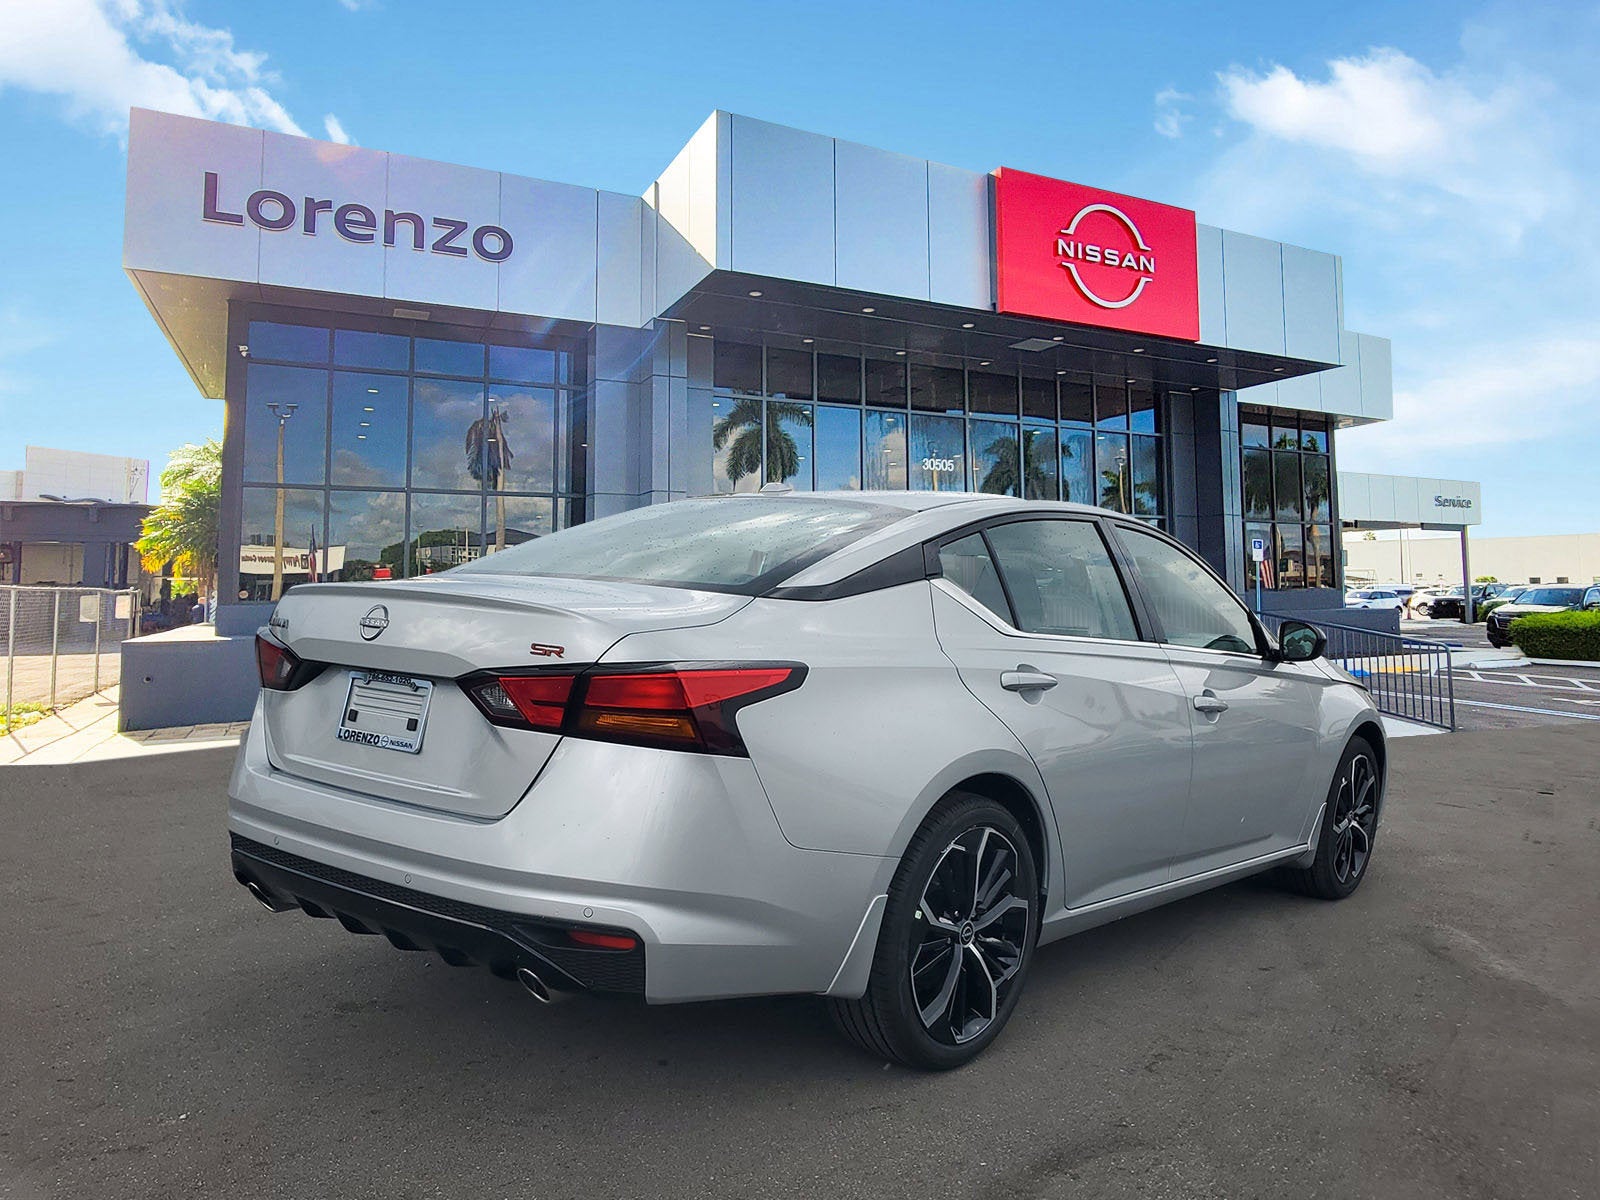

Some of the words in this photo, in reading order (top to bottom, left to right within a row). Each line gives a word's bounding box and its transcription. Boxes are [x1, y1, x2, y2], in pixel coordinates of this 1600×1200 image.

[203, 171, 514, 262] Lorenzo
[1057, 238, 1155, 273] NISSAN
[922, 458, 954, 471] 30505
[1434, 495, 1472, 508] Service
[530, 643, 564, 658] SR
[338, 727, 380, 745] LORENZO
[390, 740, 413, 749] NISSAN
